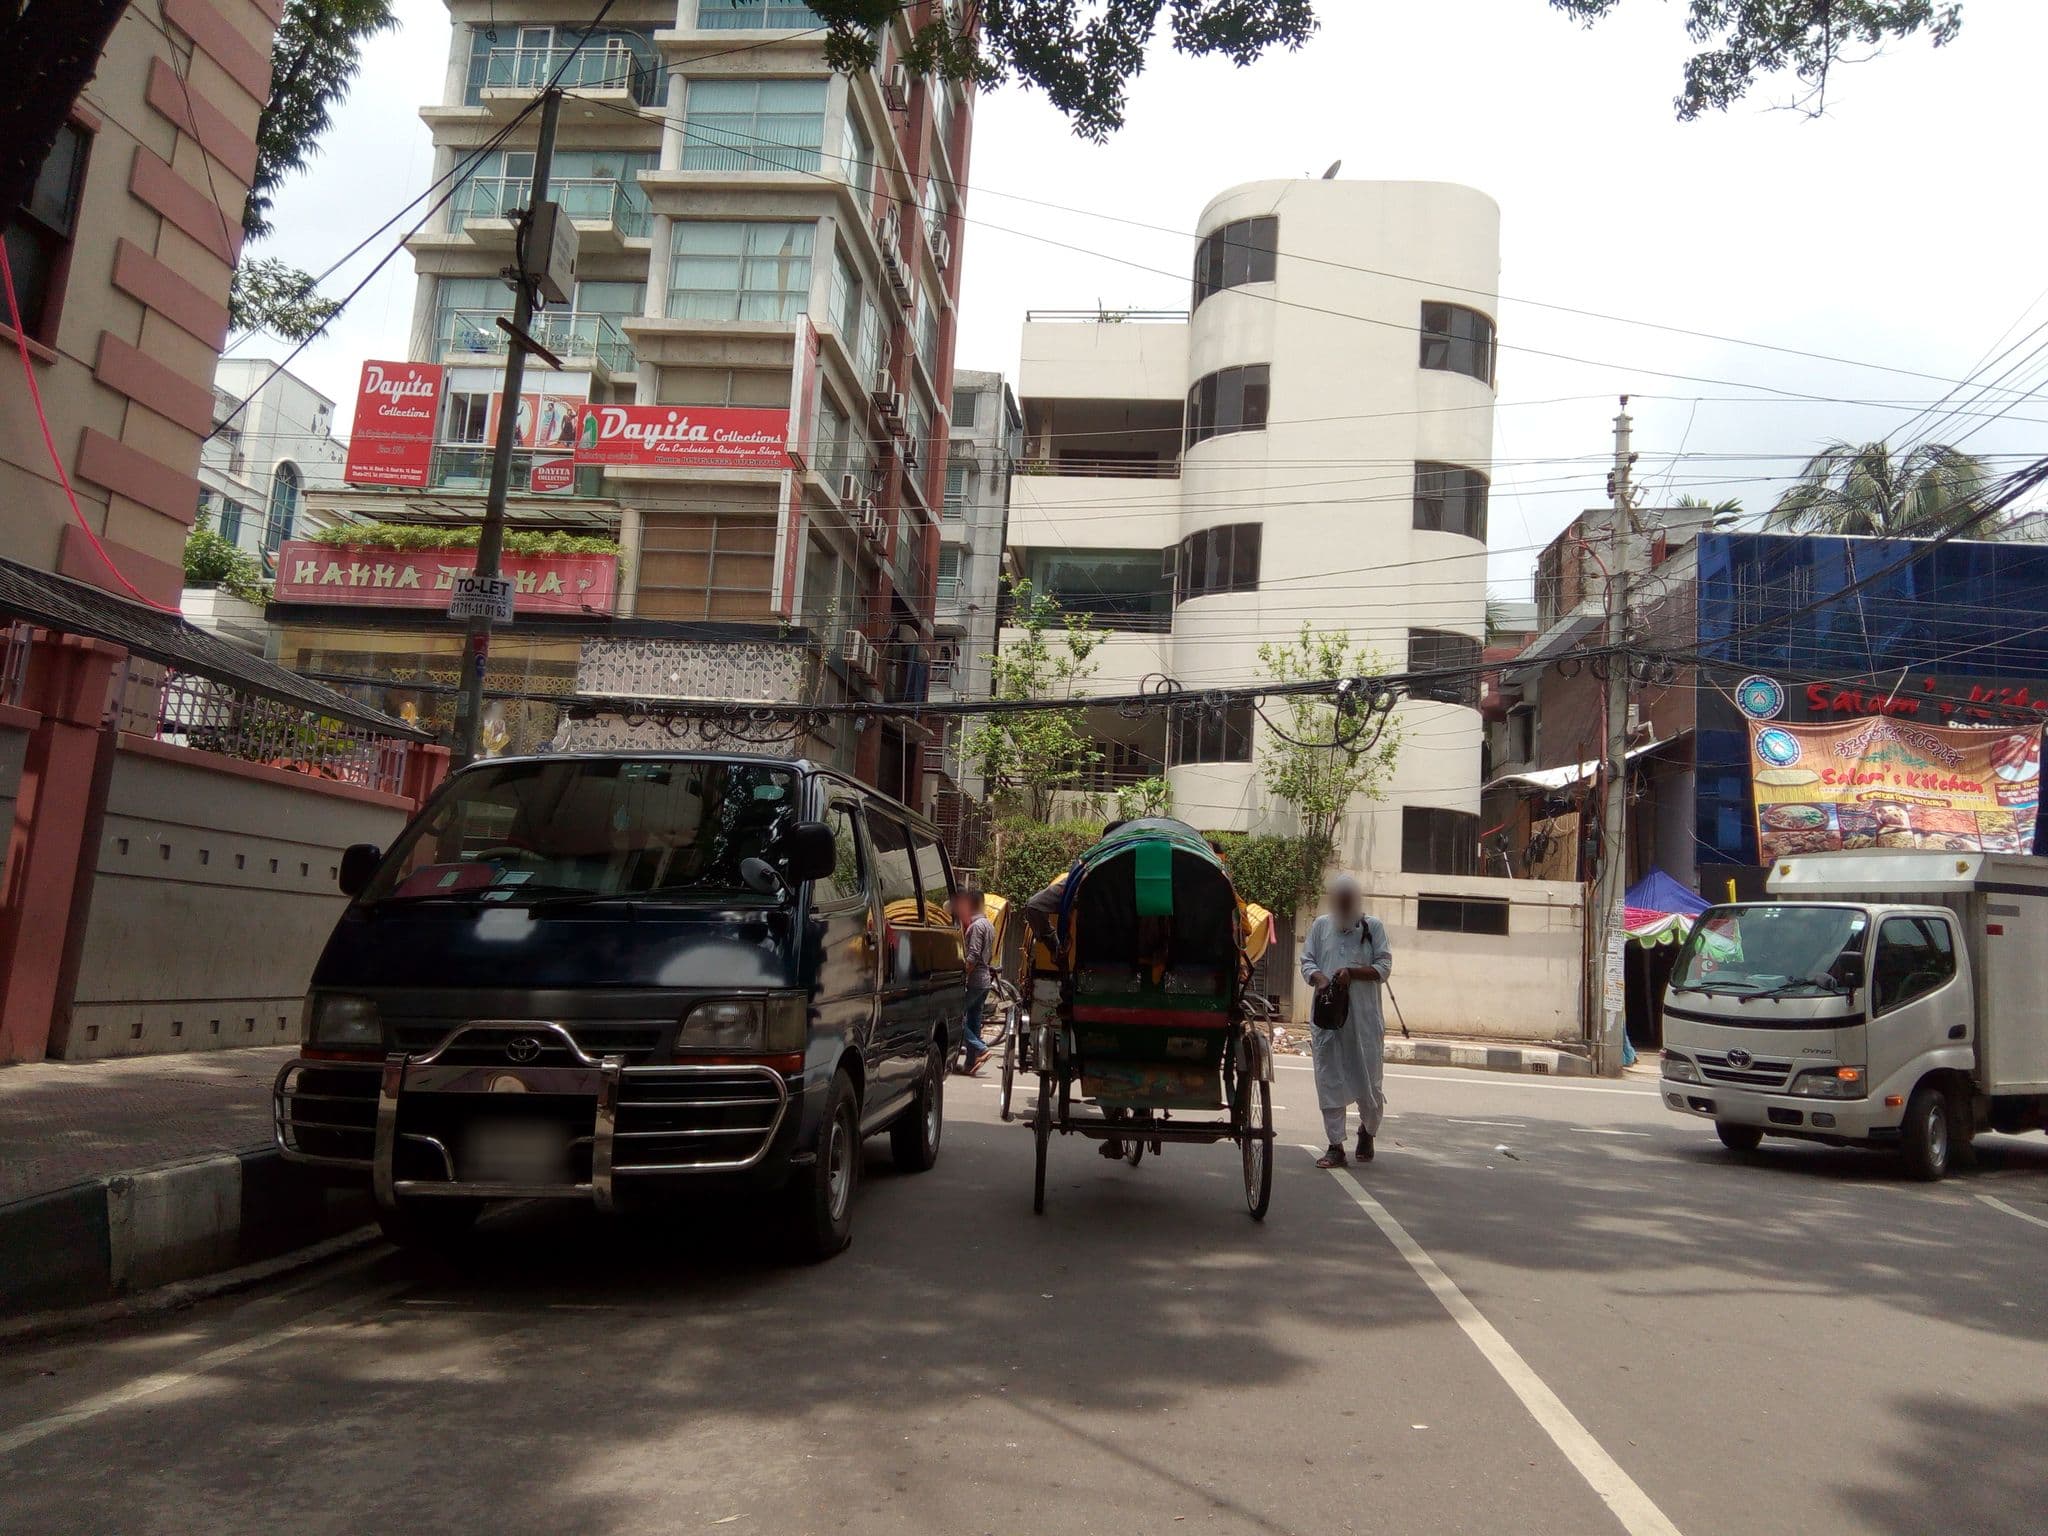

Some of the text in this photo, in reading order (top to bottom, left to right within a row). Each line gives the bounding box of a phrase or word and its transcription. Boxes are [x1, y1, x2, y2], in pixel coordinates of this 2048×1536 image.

[365, 366, 434, 404] Dayita
[379, 404, 431, 418] Collections
[600, 407, 709, 450] Dayita
[713, 429, 784, 444] Collections
[656, 443, 782, 460] An Exclusive Boutique Shop
[538, 467, 570, 475] DAYITA
[293, 560, 423, 589] HAKKA
[457, 578, 510, 596] TO-LET
[1821, 764, 1901, 786] Salam's
[1906, 770, 1984, 794] Kitchen
